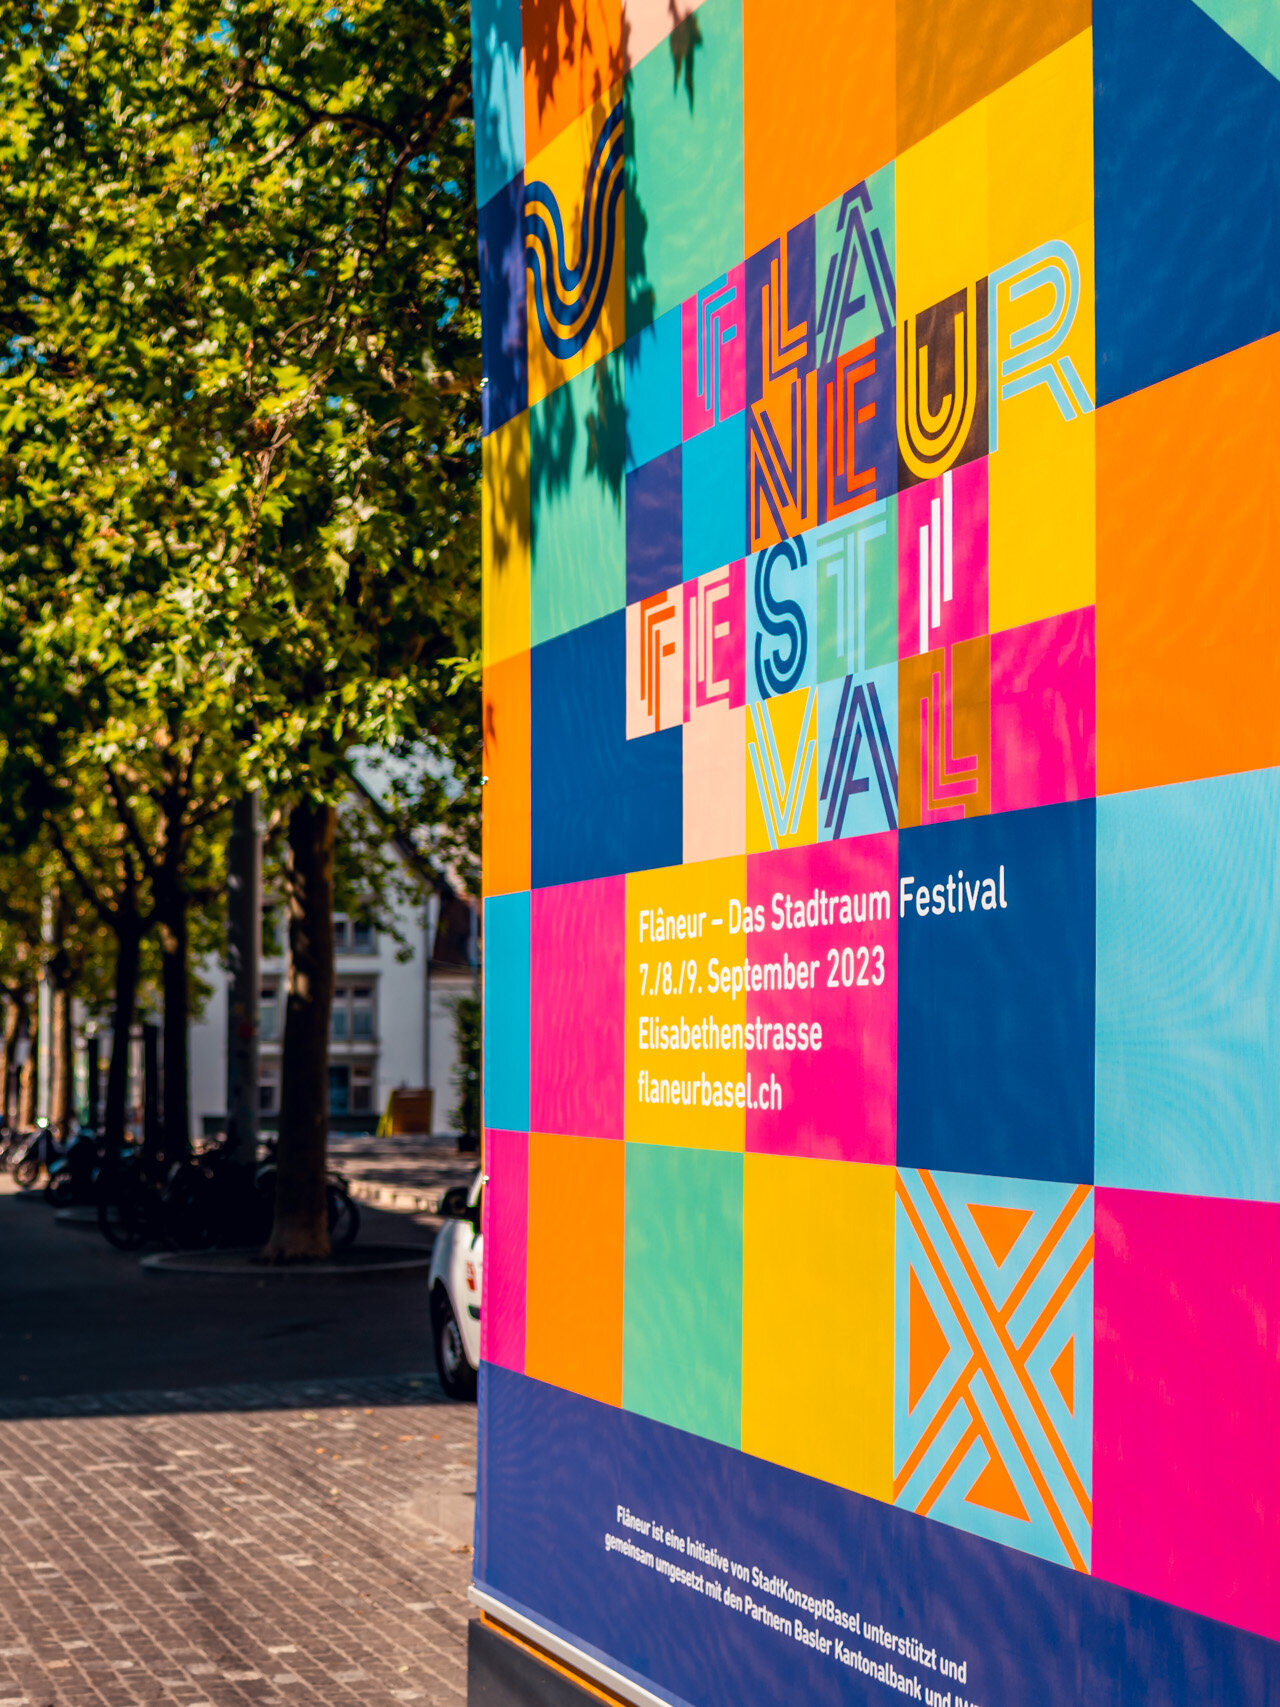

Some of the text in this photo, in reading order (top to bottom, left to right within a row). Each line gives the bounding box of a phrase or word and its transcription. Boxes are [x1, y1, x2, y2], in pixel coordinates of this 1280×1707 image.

[638, 906, 707, 943] Flâneur
[728, 898, 765, 935] Das
[771, 888, 891, 932] Stadtraum
[899, 864, 1009, 918] Festival
[638, 945, 886, 1001] 7./8./9. September 2023
[638, 1015, 823, 1051] Elisabethenstrasse
[637, 1069, 782, 1111] flaneurbasel.ch
[604, 1532, 951, 1707] gemeinsam umgesetzt mit den Partnern Basler Kantonalbank und
[616, 1504, 967, 1684] Flâneur ist eine Initiative von StadtKonzeptBasel unterstützt und
